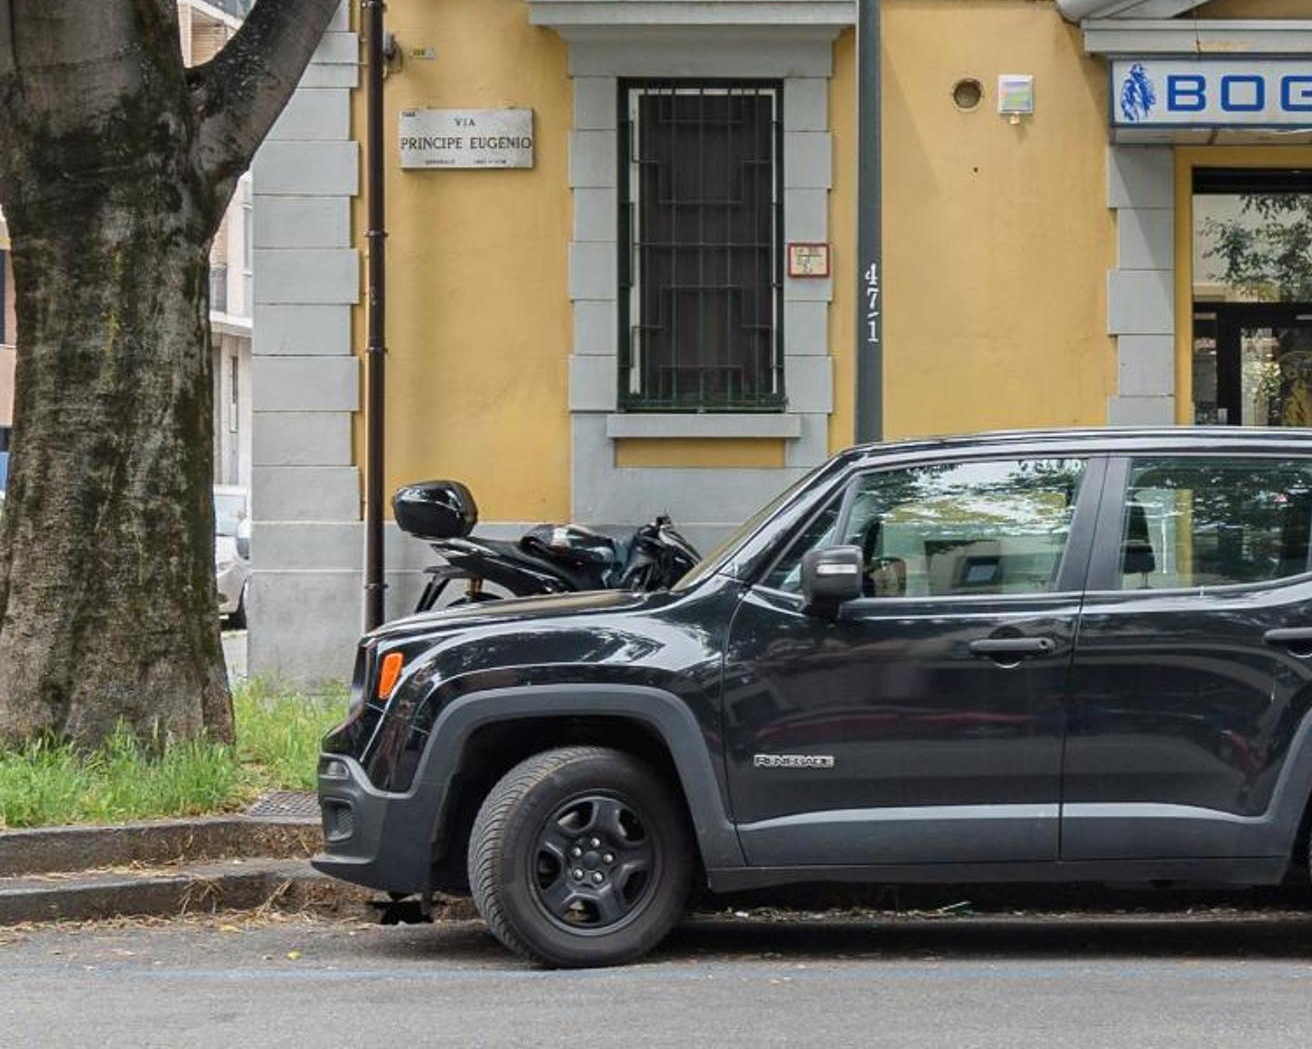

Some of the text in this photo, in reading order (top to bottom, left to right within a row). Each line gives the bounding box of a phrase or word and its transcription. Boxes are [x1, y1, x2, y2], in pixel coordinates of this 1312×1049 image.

[454, 118, 476, 127] VIA
[401, 137, 532, 150] PRINCIPE EUGENIO
